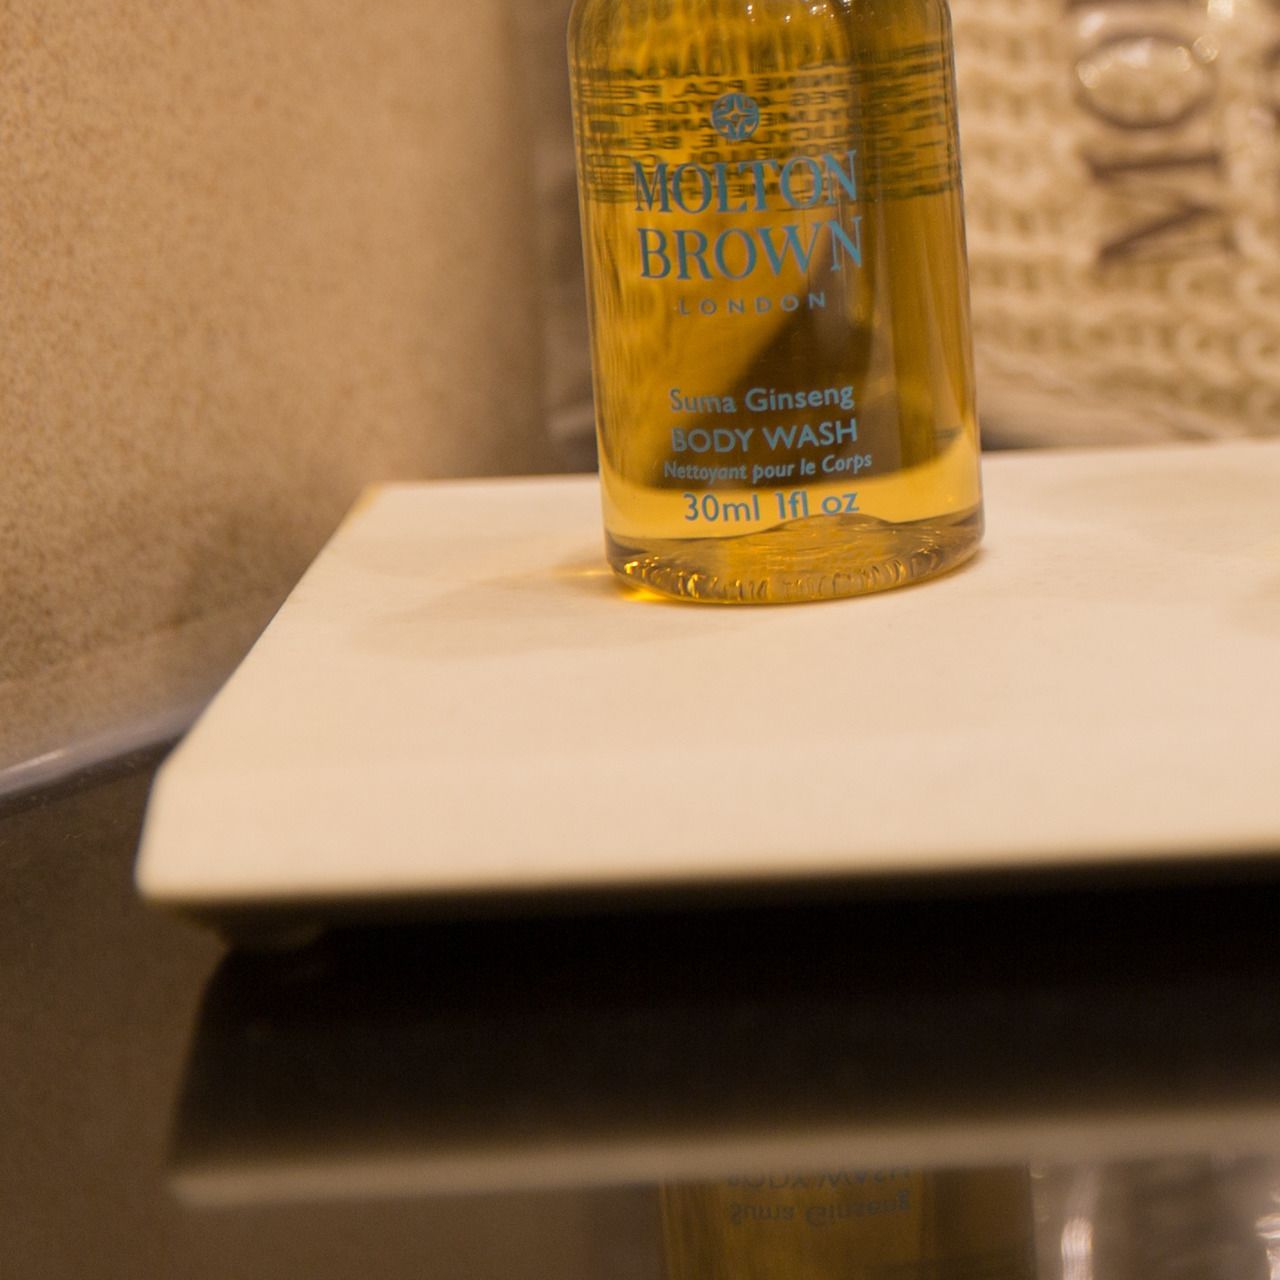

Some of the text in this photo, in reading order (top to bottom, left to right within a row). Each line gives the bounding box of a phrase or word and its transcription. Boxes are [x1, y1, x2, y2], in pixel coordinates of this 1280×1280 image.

[633, 150, 858, 214] MOLTON
[636, 216, 864, 280] BROWN
[678, 291, 828, 316] LONDON
[669, 384, 855, 414] Suma Ginseng
[672, 418, 858, 453] BODY WASH
[663, 451, 873, 484] Nettoyant pour le Corps
[683, 493, 760, 522] 30ml
[821, 491, 860, 515] oz
